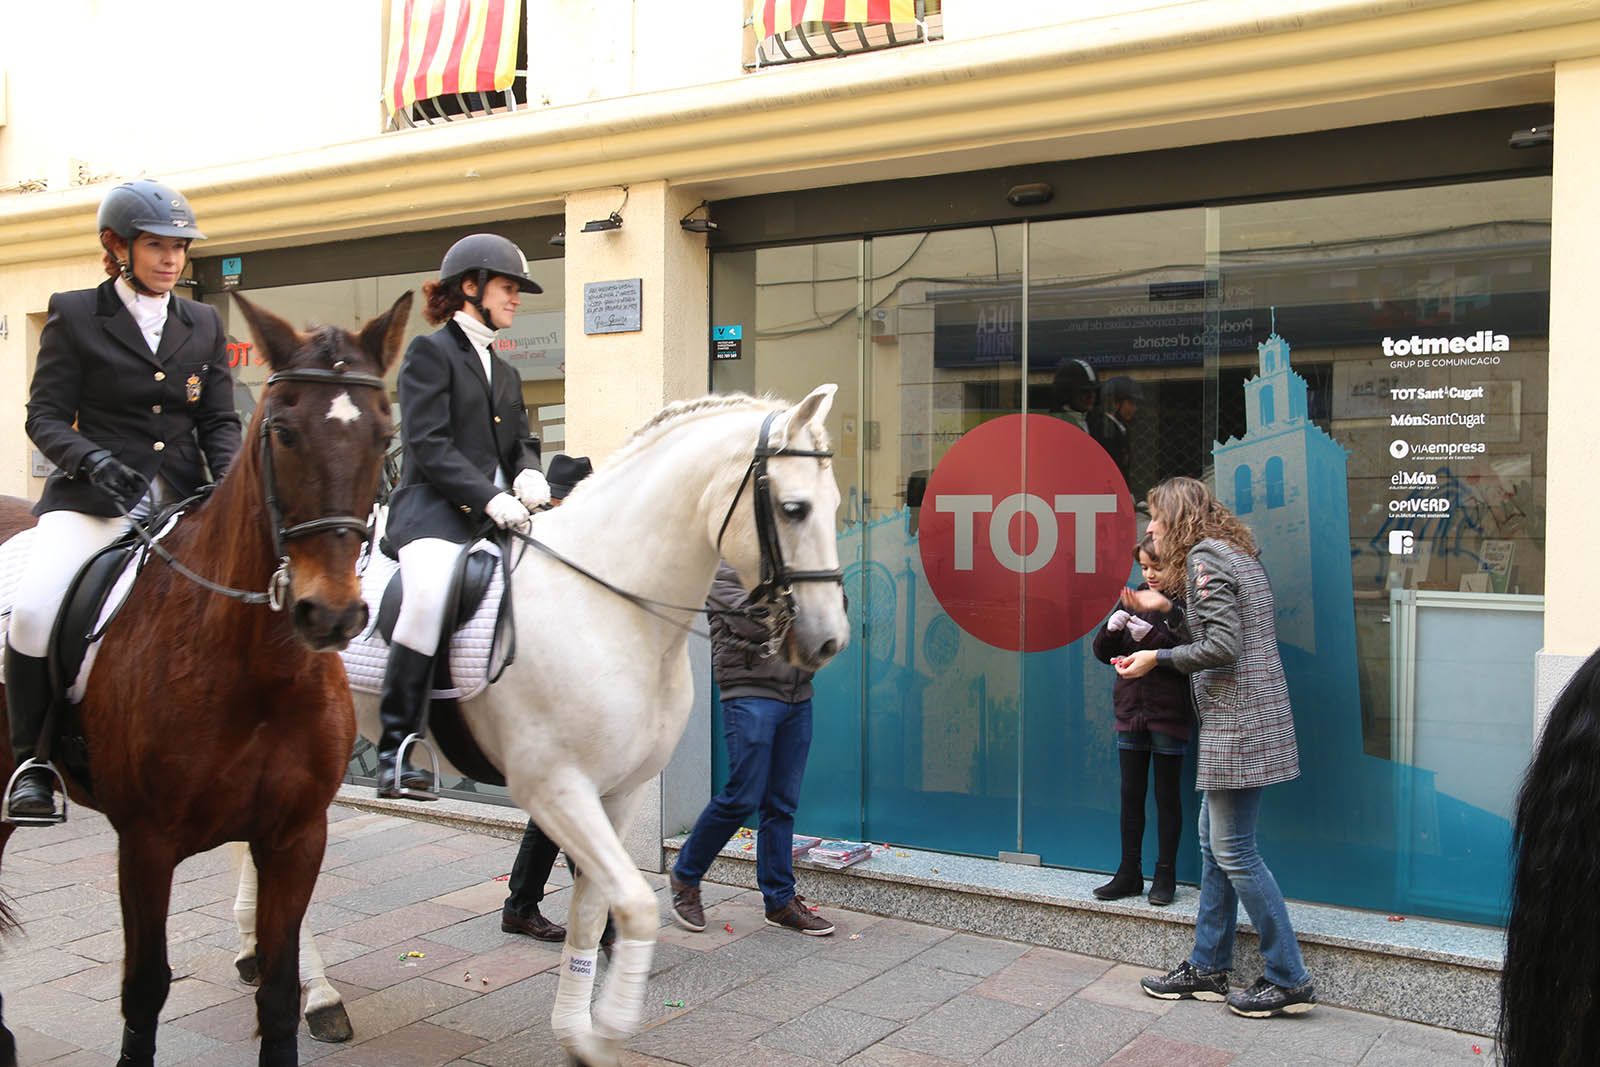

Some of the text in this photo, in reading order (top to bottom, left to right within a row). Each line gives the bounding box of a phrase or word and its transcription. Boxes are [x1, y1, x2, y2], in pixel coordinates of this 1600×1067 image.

[225, 342, 251, 368] OT
[1382, 330, 1510, 357] totmedia
[1390, 359, 1416, 369] GRUP
[1417, 359, 1430, 368] DE
[935, 493, 1117, 574] TOT
